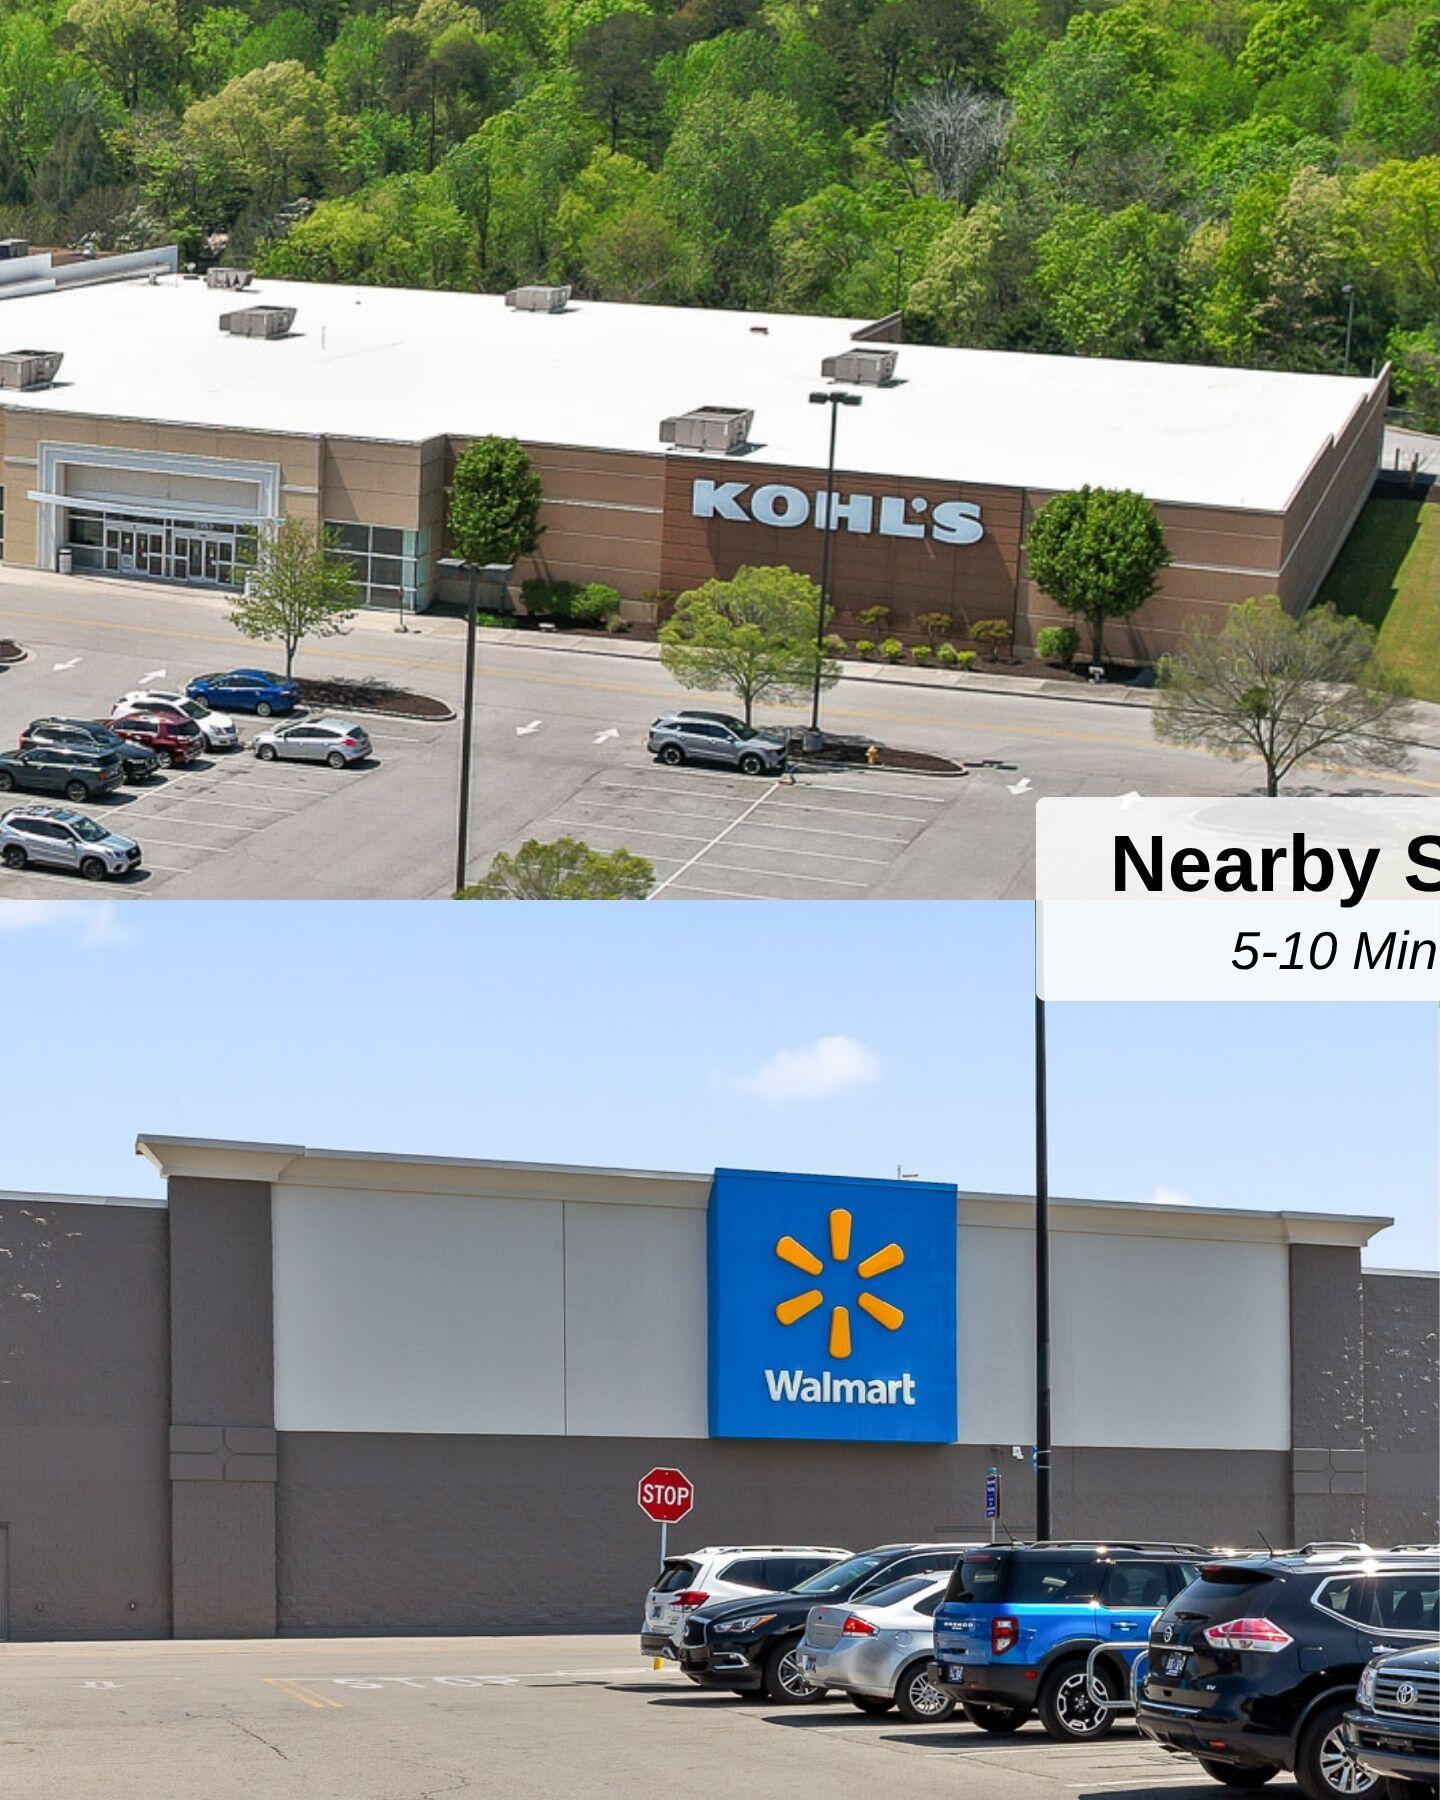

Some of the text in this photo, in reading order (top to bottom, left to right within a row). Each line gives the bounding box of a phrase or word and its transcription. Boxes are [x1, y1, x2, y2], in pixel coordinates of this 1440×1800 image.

[693, 480, 984, 544] KOHL'S
[765, 1370, 915, 1405] Walmart
[642, 1483, 690, 1506] STOP
